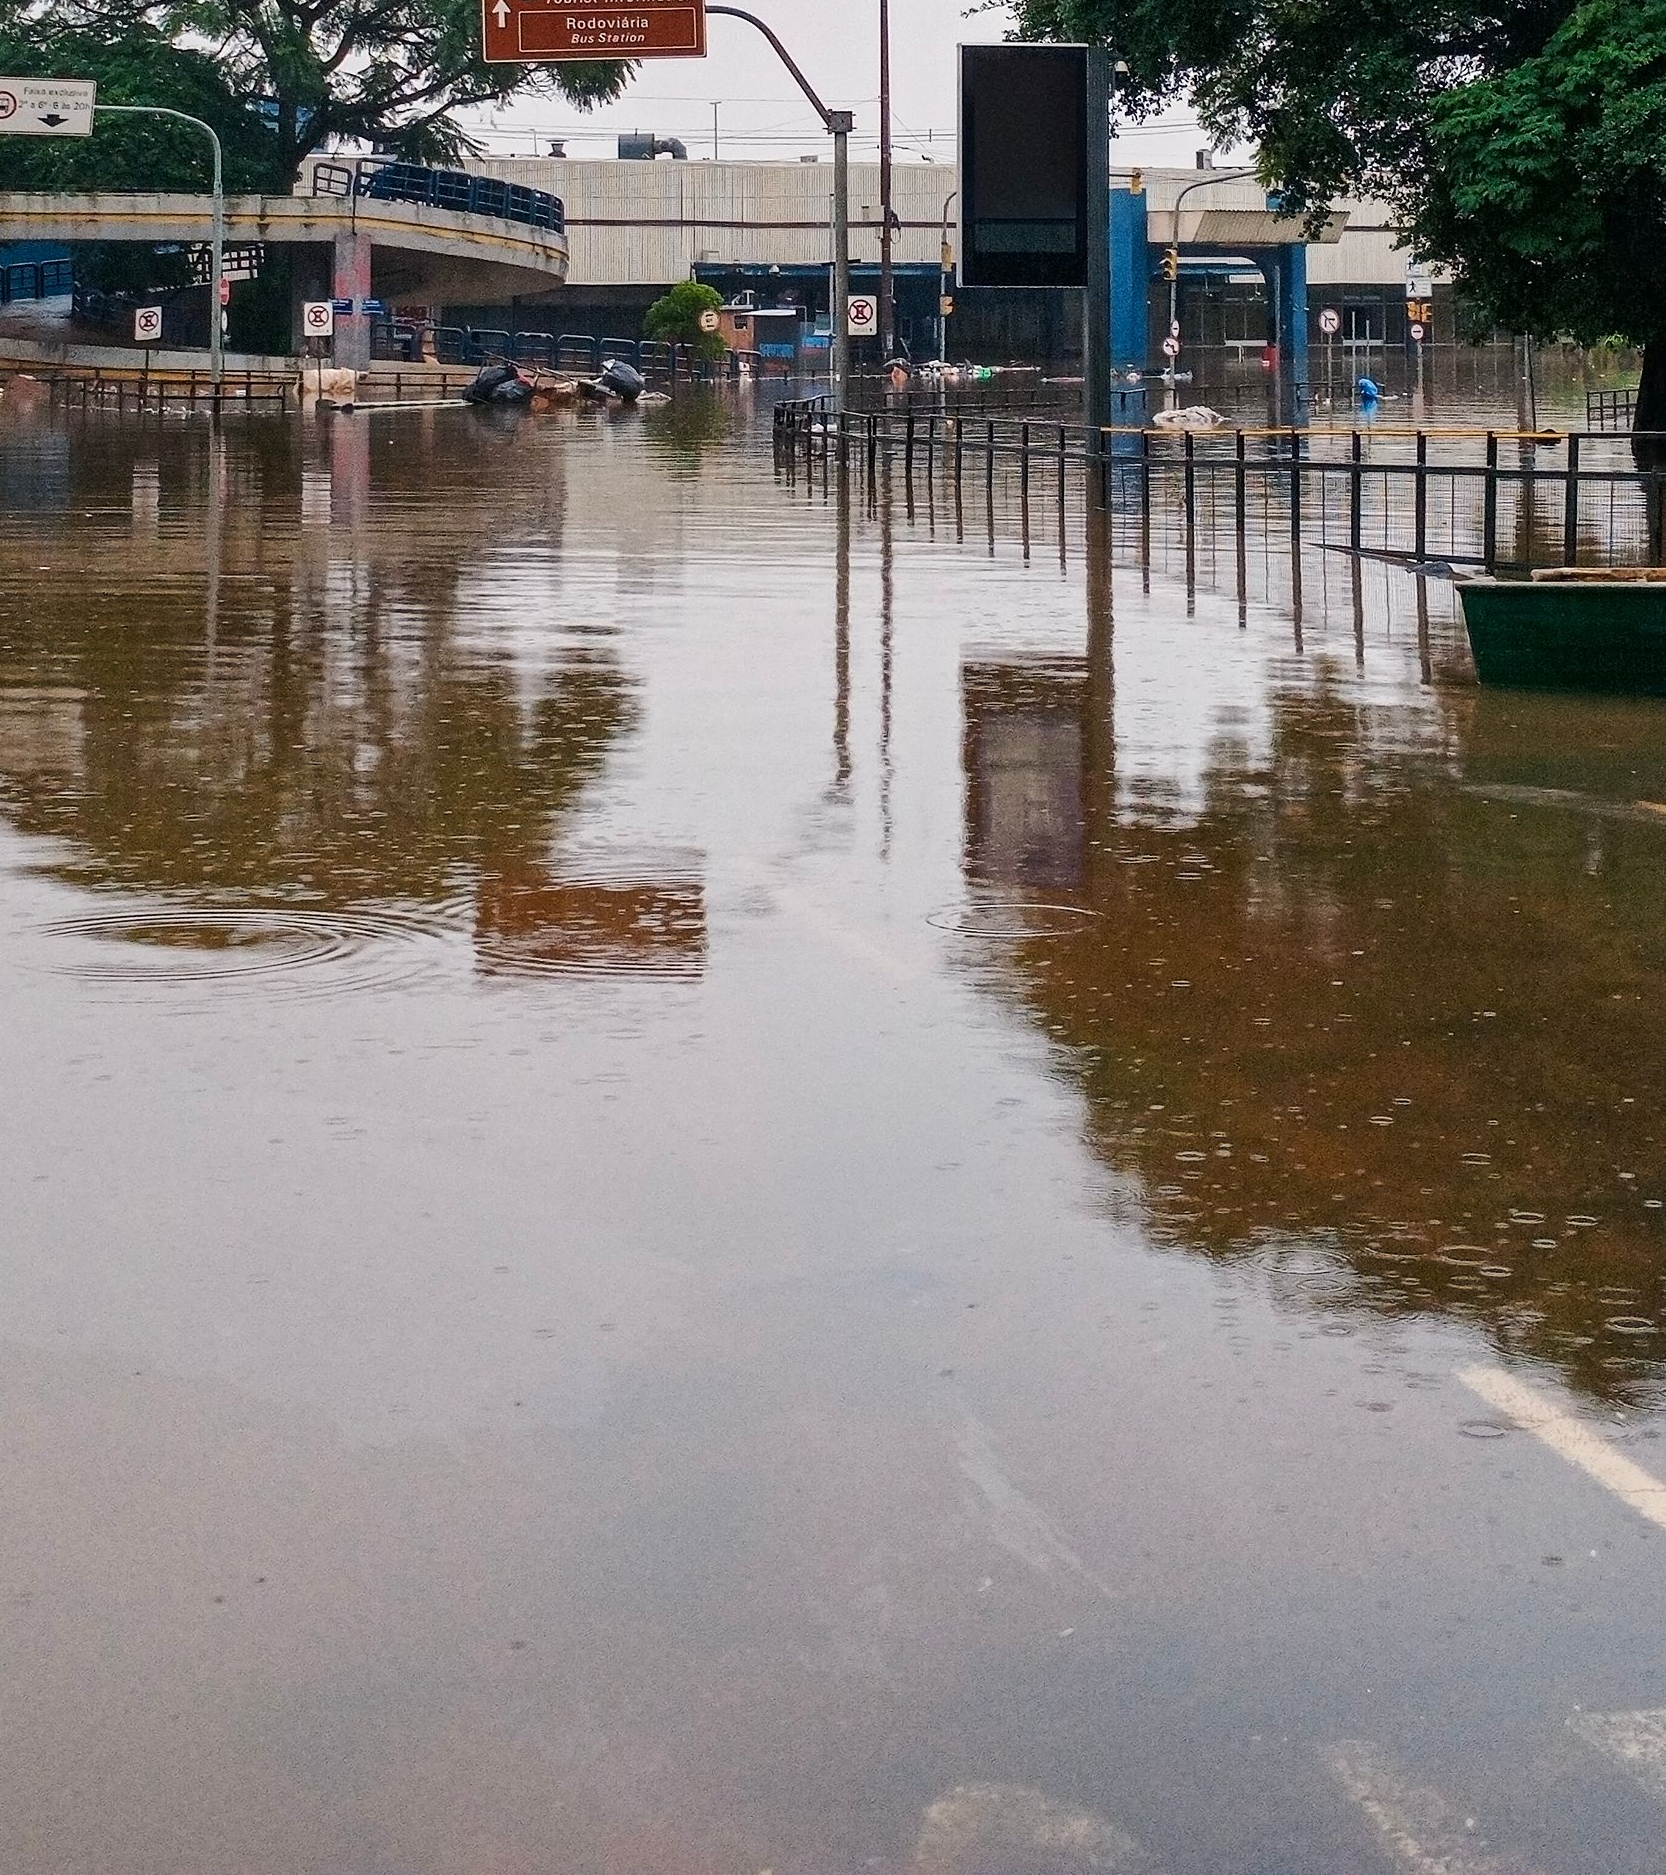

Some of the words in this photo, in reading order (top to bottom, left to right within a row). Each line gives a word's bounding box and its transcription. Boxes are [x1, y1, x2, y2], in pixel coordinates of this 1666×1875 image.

[566, 16, 649, 30] Rodoviária
[571, 33, 594, 44] Bus
[598, 31, 645, 44] Station
